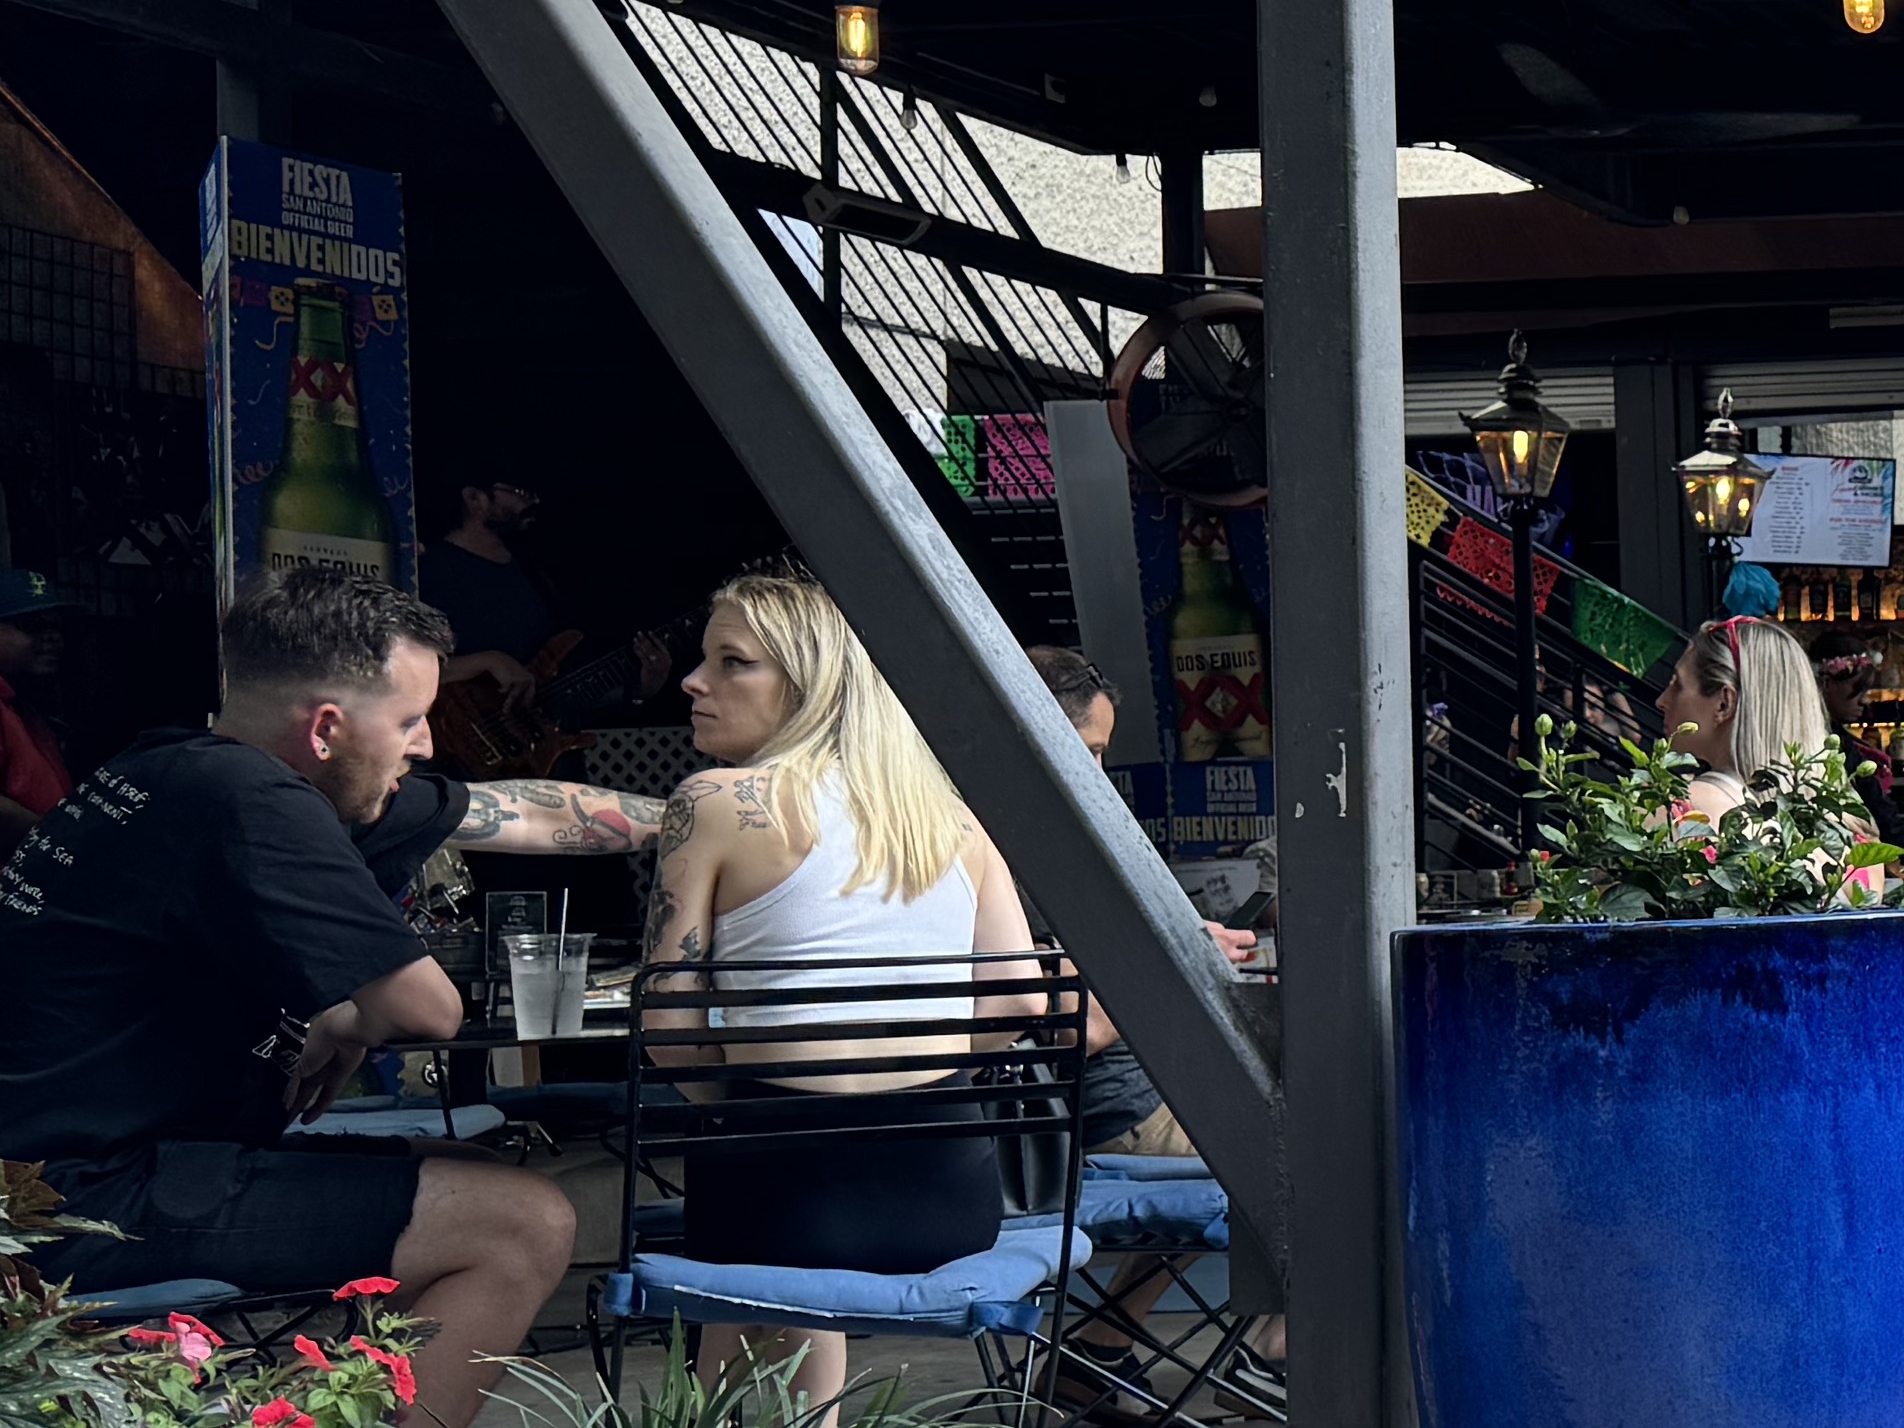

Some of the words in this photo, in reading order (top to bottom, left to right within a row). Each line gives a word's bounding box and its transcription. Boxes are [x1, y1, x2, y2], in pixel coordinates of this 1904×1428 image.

[281, 157, 353, 206] FIESTA
[281, 193, 305, 213] SAN
[305, 199, 354, 224] ANTONIO
[281, 210, 327, 233] OFFICIAL
[326, 220, 354, 239] BEER
[229, 218, 401, 288] BIENVENIDOS
[1176, 654, 1206, 672] DOS
[1210, 650, 1257, 671] EQUIS
[1205, 764, 1257, 792] FIESTA
[1173, 815, 1277, 842] BIENVENIDO
